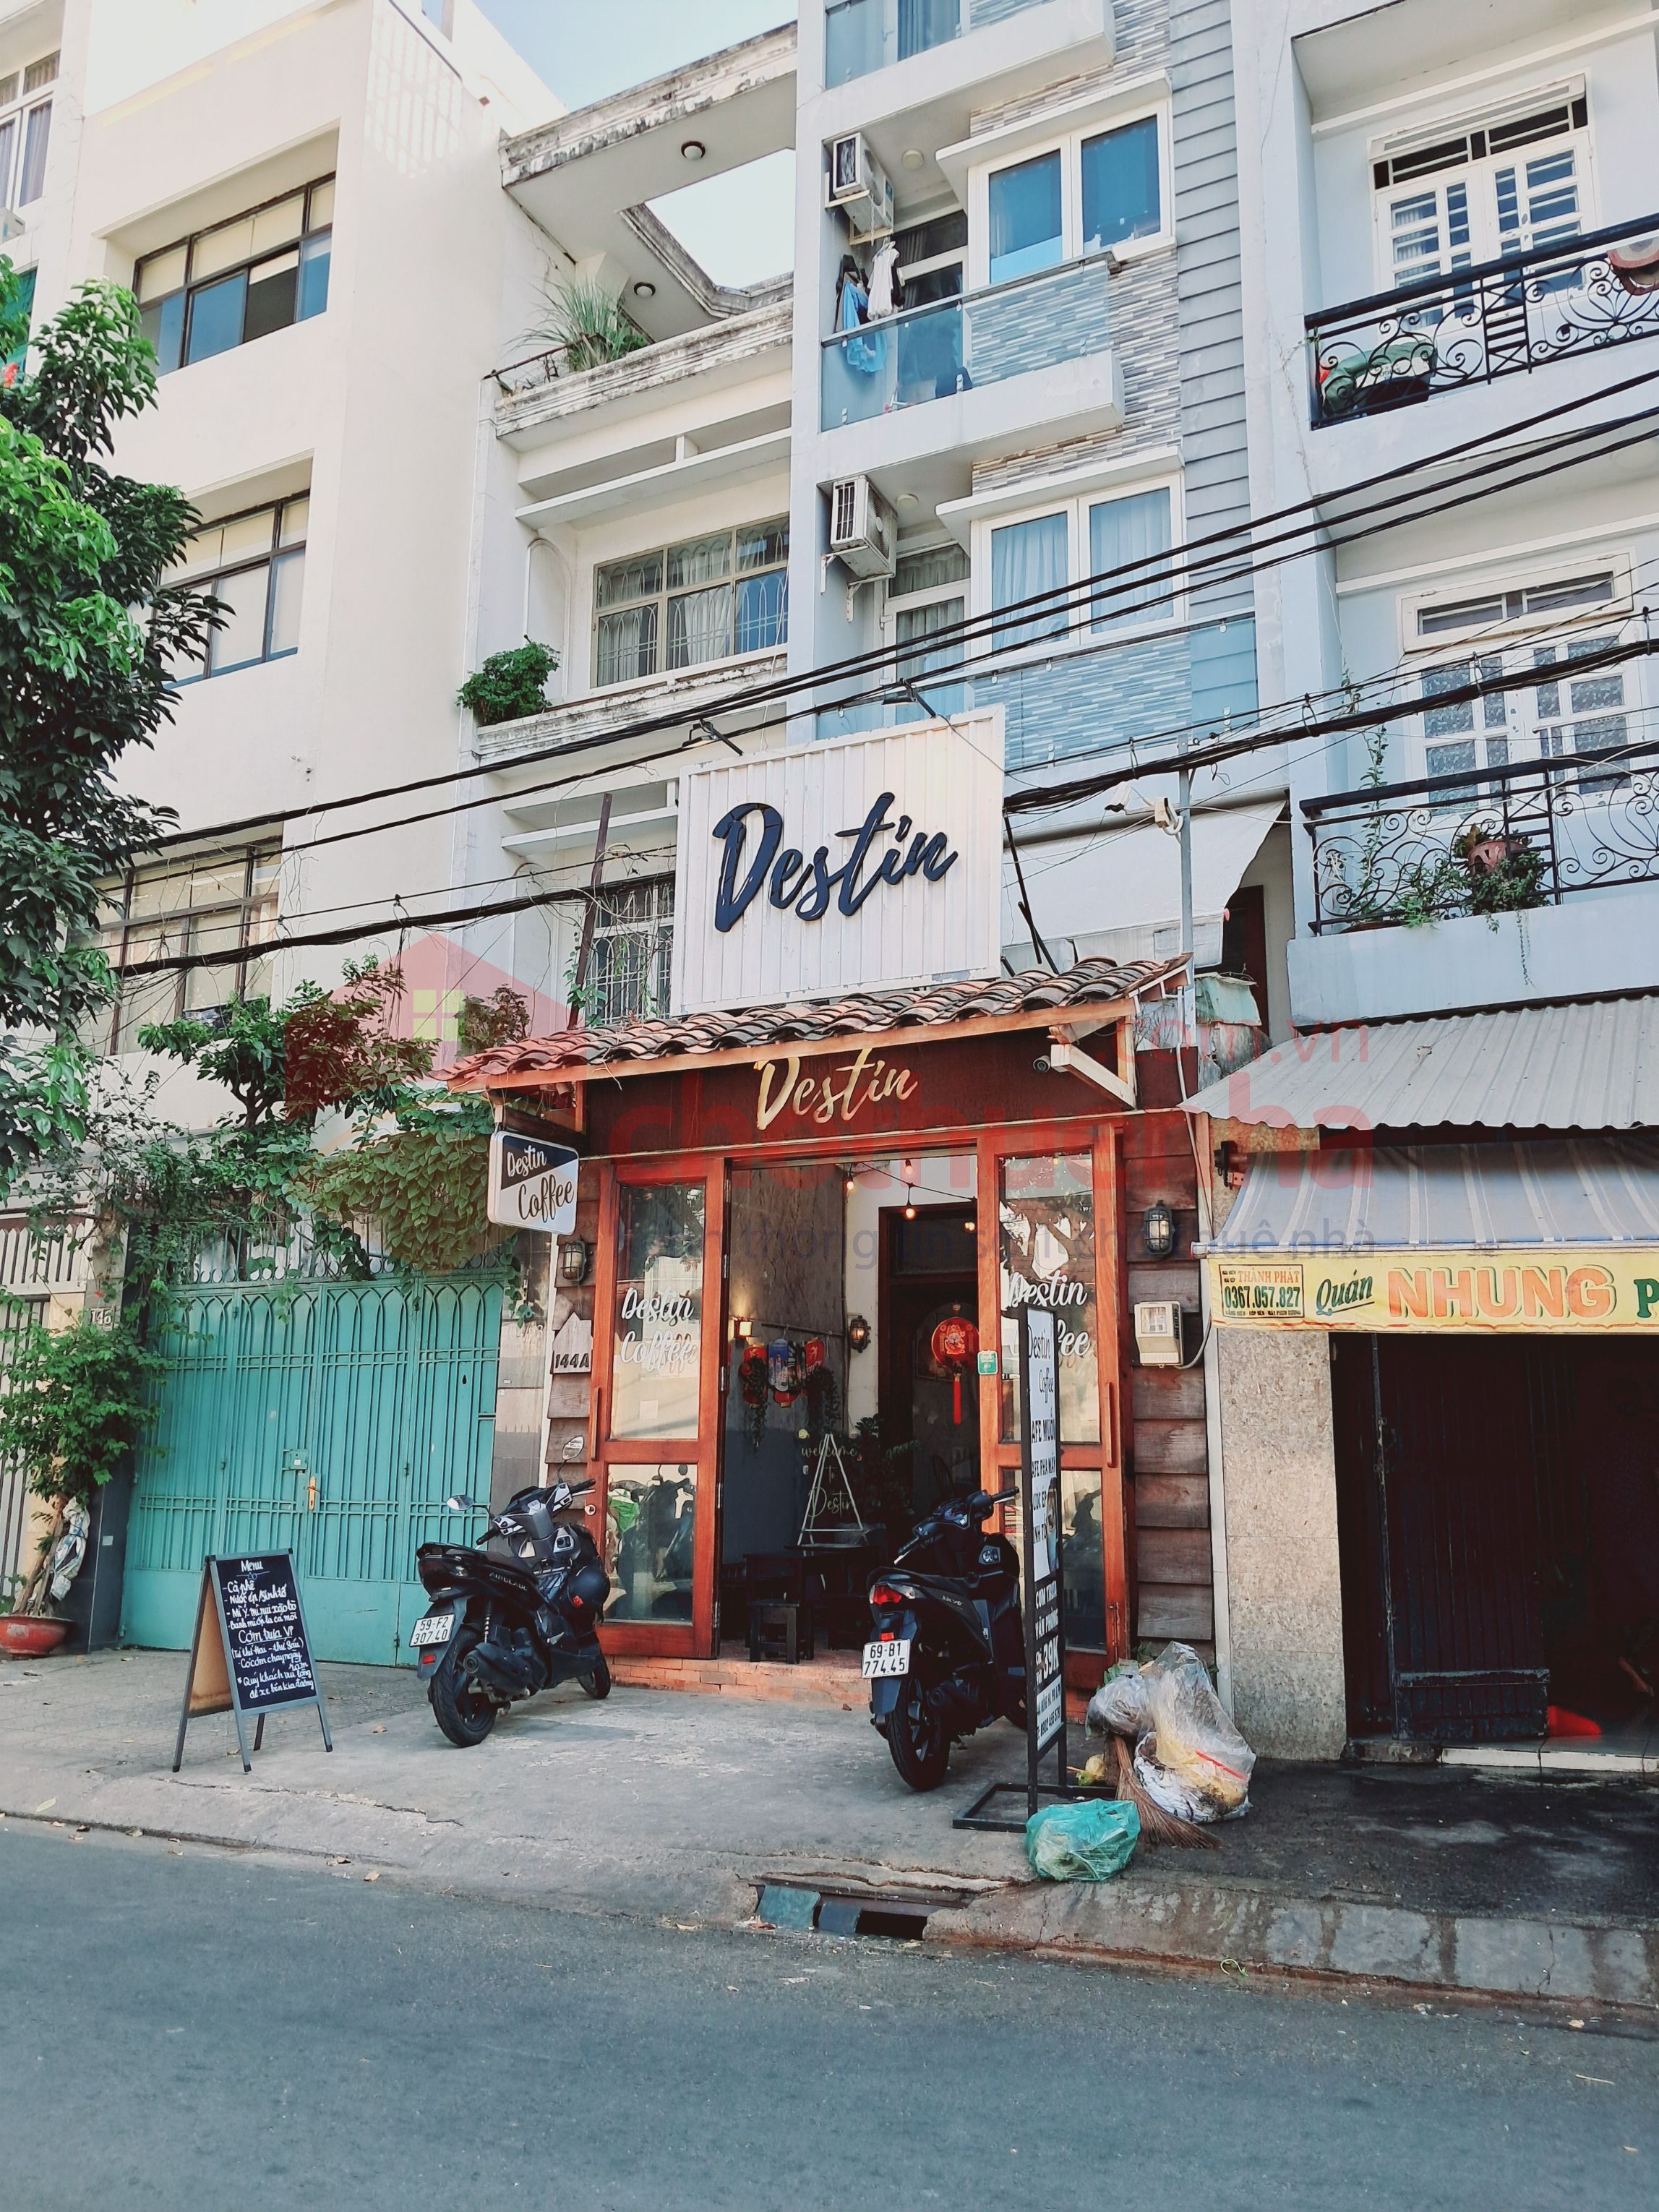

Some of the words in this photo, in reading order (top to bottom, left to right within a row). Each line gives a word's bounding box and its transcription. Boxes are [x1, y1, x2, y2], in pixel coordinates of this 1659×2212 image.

[712, 792, 959, 933] Destin
[753, 1047, 918, 1130] Destin
[507, 1144, 547, 1178] Destin
[518, 1174, 575, 1223] Coffee
[1009, 1270, 1088, 1308] Destin
[1274, 1268, 1300, 1283] PHÁT
[1316, 1269, 1373, 1316] Quán
[1388, 1265, 1617, 1318] NHUNG
[622, 1286, 695, 1324] Destin
[1225, 1285, 1300, 1308] 0367.057.827
[621, 1330, 695, 1372] Coffee
[1026, 1327, 1051, 1359] Destin
[555, 1353, 589, 1368] 144A
[1032, 1420, 1042, 1443] AFE
[241, 1559, 264, 1572] Menu
[238, 1629, 264, 1644] Cơm
[283, 1625, 294, 1637] VP
[419, 1616, 449, 1632] 59-F2
[870, 1642, 901, 1659] 69-B1
[1043, 1634, 1060, 1679] 39K
[864, 1658, 906, 1676] 774.45
